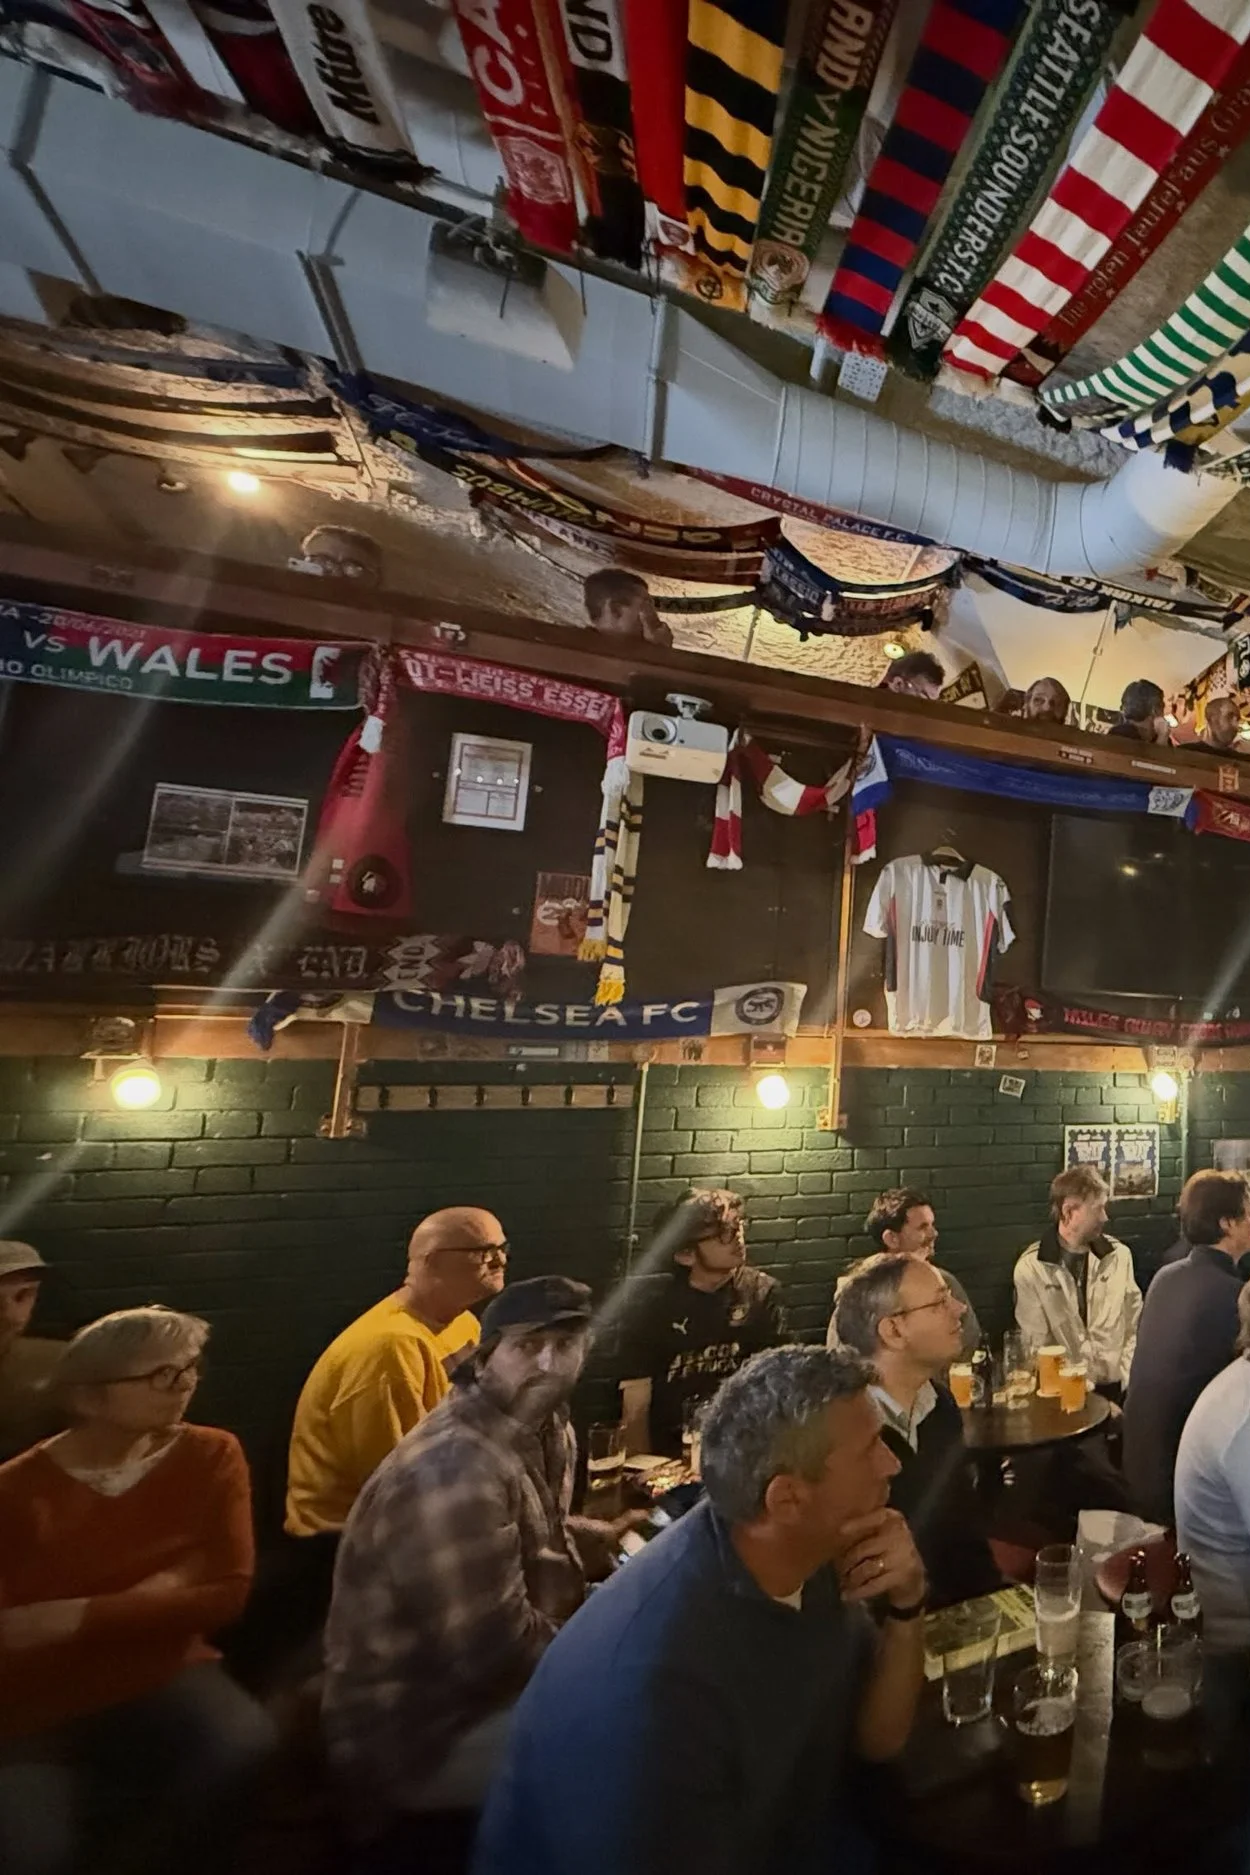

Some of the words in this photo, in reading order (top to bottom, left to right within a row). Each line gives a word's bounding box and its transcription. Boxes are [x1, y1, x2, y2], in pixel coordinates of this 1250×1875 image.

[1019, 0, 1101, 129] SEATTLE
[771, 113, 841, 248] NIGERIA
[953, 125, 1038, 266] SOUNDERS
[1124, 179, 1183, 250] Teufel
[1179, 135, 1220, 182] aus
[750, 486, 818, 520] CRYSTAL
[822, 512, 882, 538] PALACE
[24, 631, 68, 653] VS
[88, 635, 294, 686] WALES
[31, 661, 135, 691] OLIMPICO
[942, 927, 965, 947] TIME
[392, 989, 627, 1027] CHELSEA
[642, 1001, 699, 1024] FC
